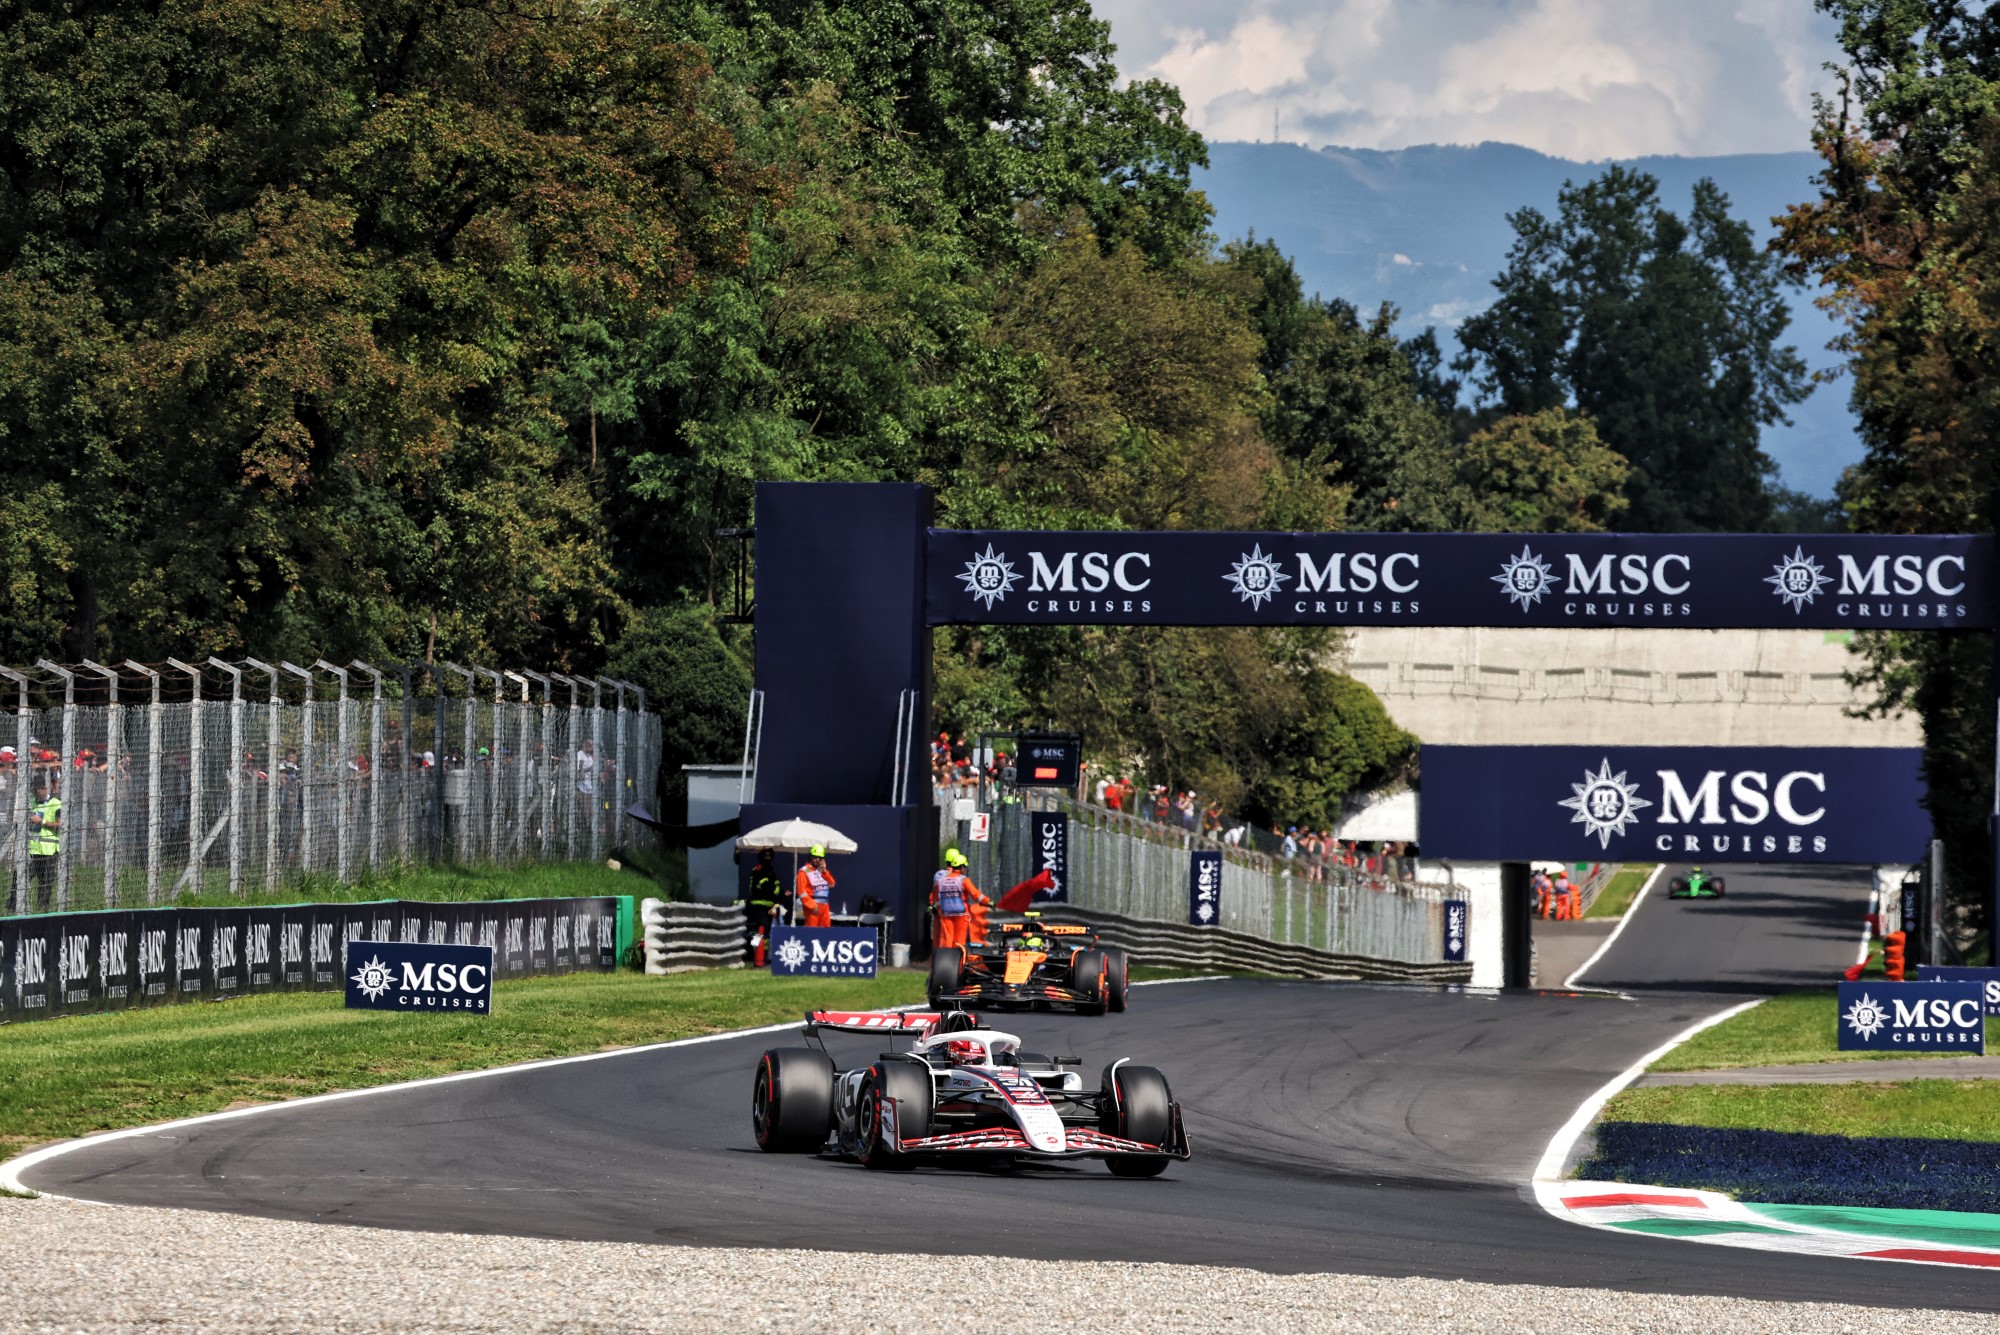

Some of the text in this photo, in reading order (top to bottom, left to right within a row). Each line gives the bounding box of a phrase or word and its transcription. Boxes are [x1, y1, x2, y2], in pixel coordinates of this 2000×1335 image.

[1028, 551, 1151, 593] MSC
[1295, 552, 1420, 593] MSC
[1564, 553, 1691, 595] MSC
[1837, 554, 1965, 596] MSC
[1028, 600, 1151, 613] CRUISES
[1295, 600, 1419, 613] CRUISES
[1565, 602, 1691, 616] CRUISES
[1837, 603, 1967, 618] CRUISES
[1043, 748, 1064, 758] MSC
[1656, 770, 1826, 825] MSC
[1043, 823, 1057, 871] MSC
[1656, 834, 1827, 853] CRUISES
[1198, 860, 1213, 901] MSC
[1449, 906, 1459, 938] MSC
[25, 938, 46, 984] MSC
[69, 935, 89, 979] MSC
[109, 932, 128, 975] MSC
[148, 930, 166, 973] MSC
[183, 927, 200, 970] MSC
[220, 926, 237, 968] MSC
[254, 924, 271, 964] MSC
[287, 923, 303, 962] MSC
[317, 923, 333, 963] MSC
[811, 939, 874, 964] MSC
[400, 962, 486, 994] MSC
[399, 996, 485, 1008] CRUISES
[1892, 999, 1979, 1028] MSC
[1892, 1032, 1980, 1043] CRUISES
